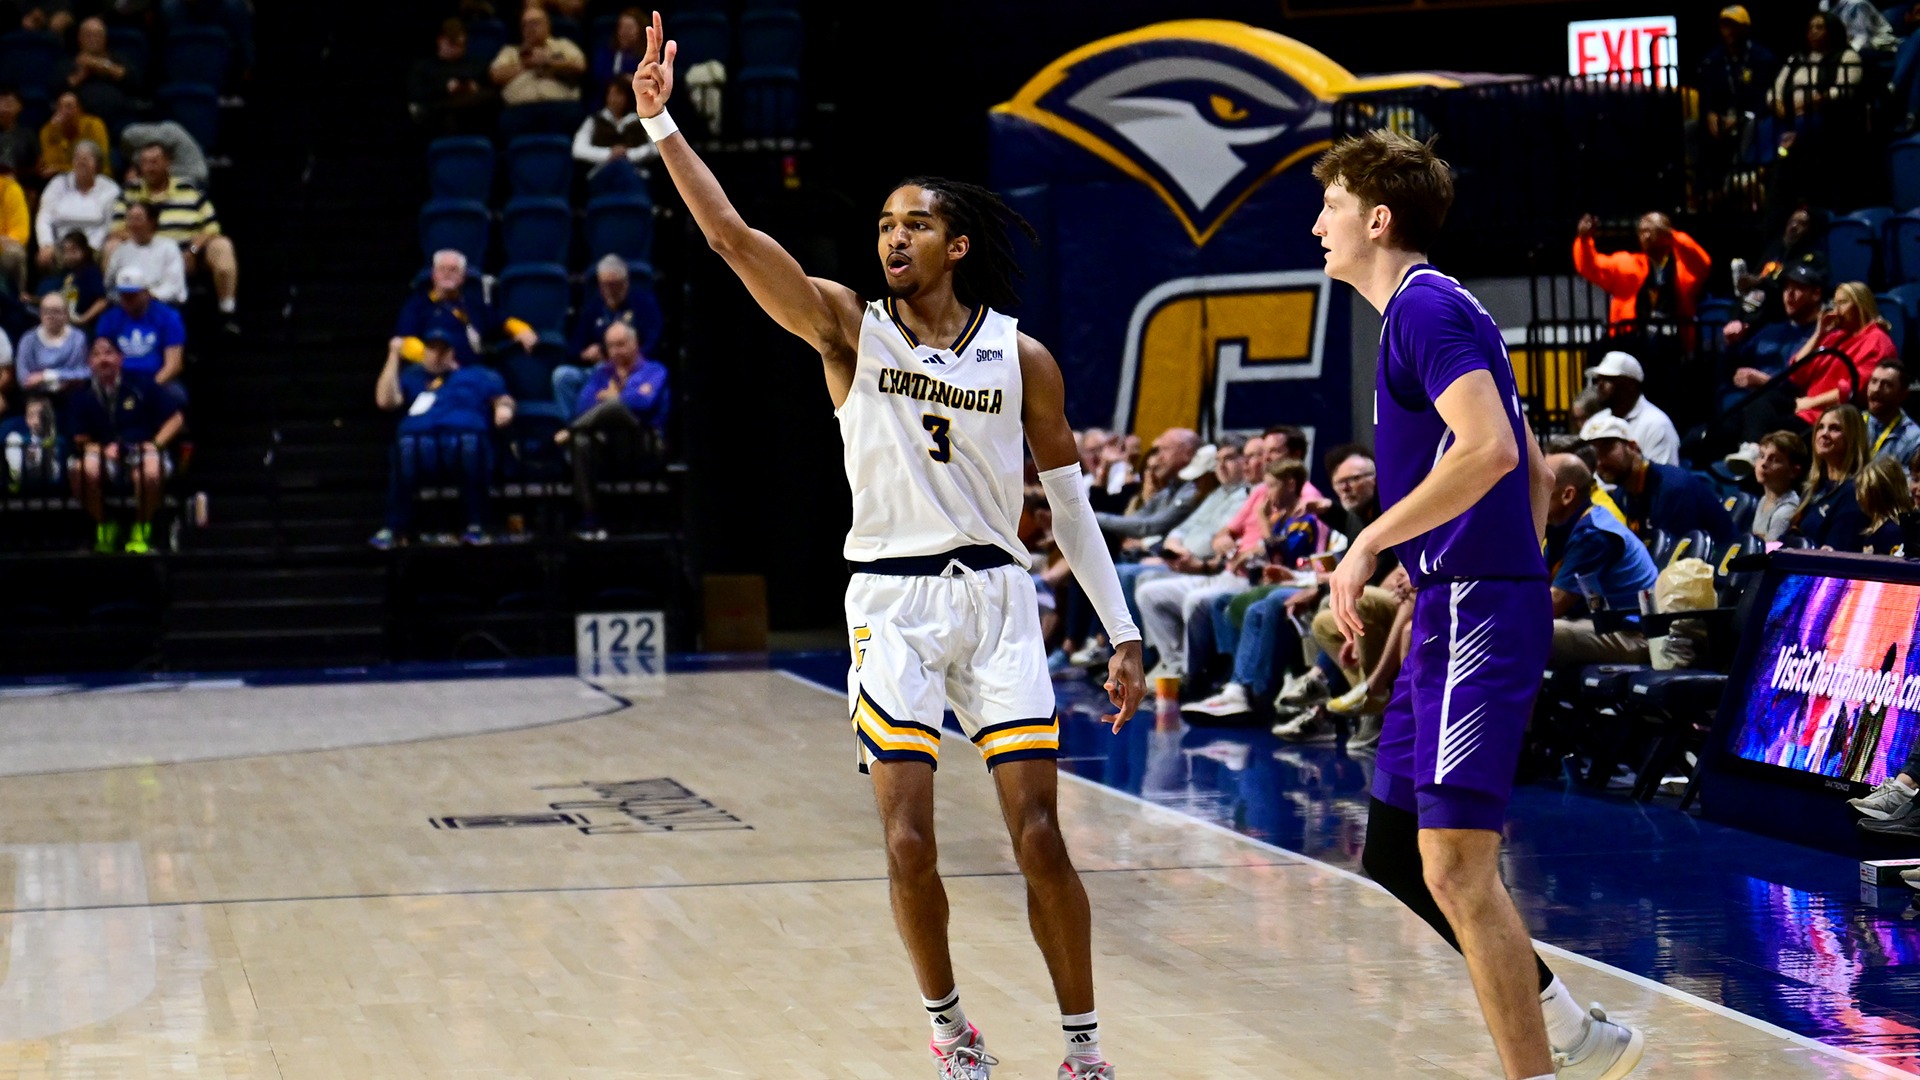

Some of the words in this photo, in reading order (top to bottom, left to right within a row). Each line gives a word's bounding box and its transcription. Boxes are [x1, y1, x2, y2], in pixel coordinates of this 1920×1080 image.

[1578, 27, 1668, 86] EXIT
[878, 367, 1003, 415] CHATTANOOGA
[922, 414, 952, 464] 3
[585, 617, 656, 653] 122
